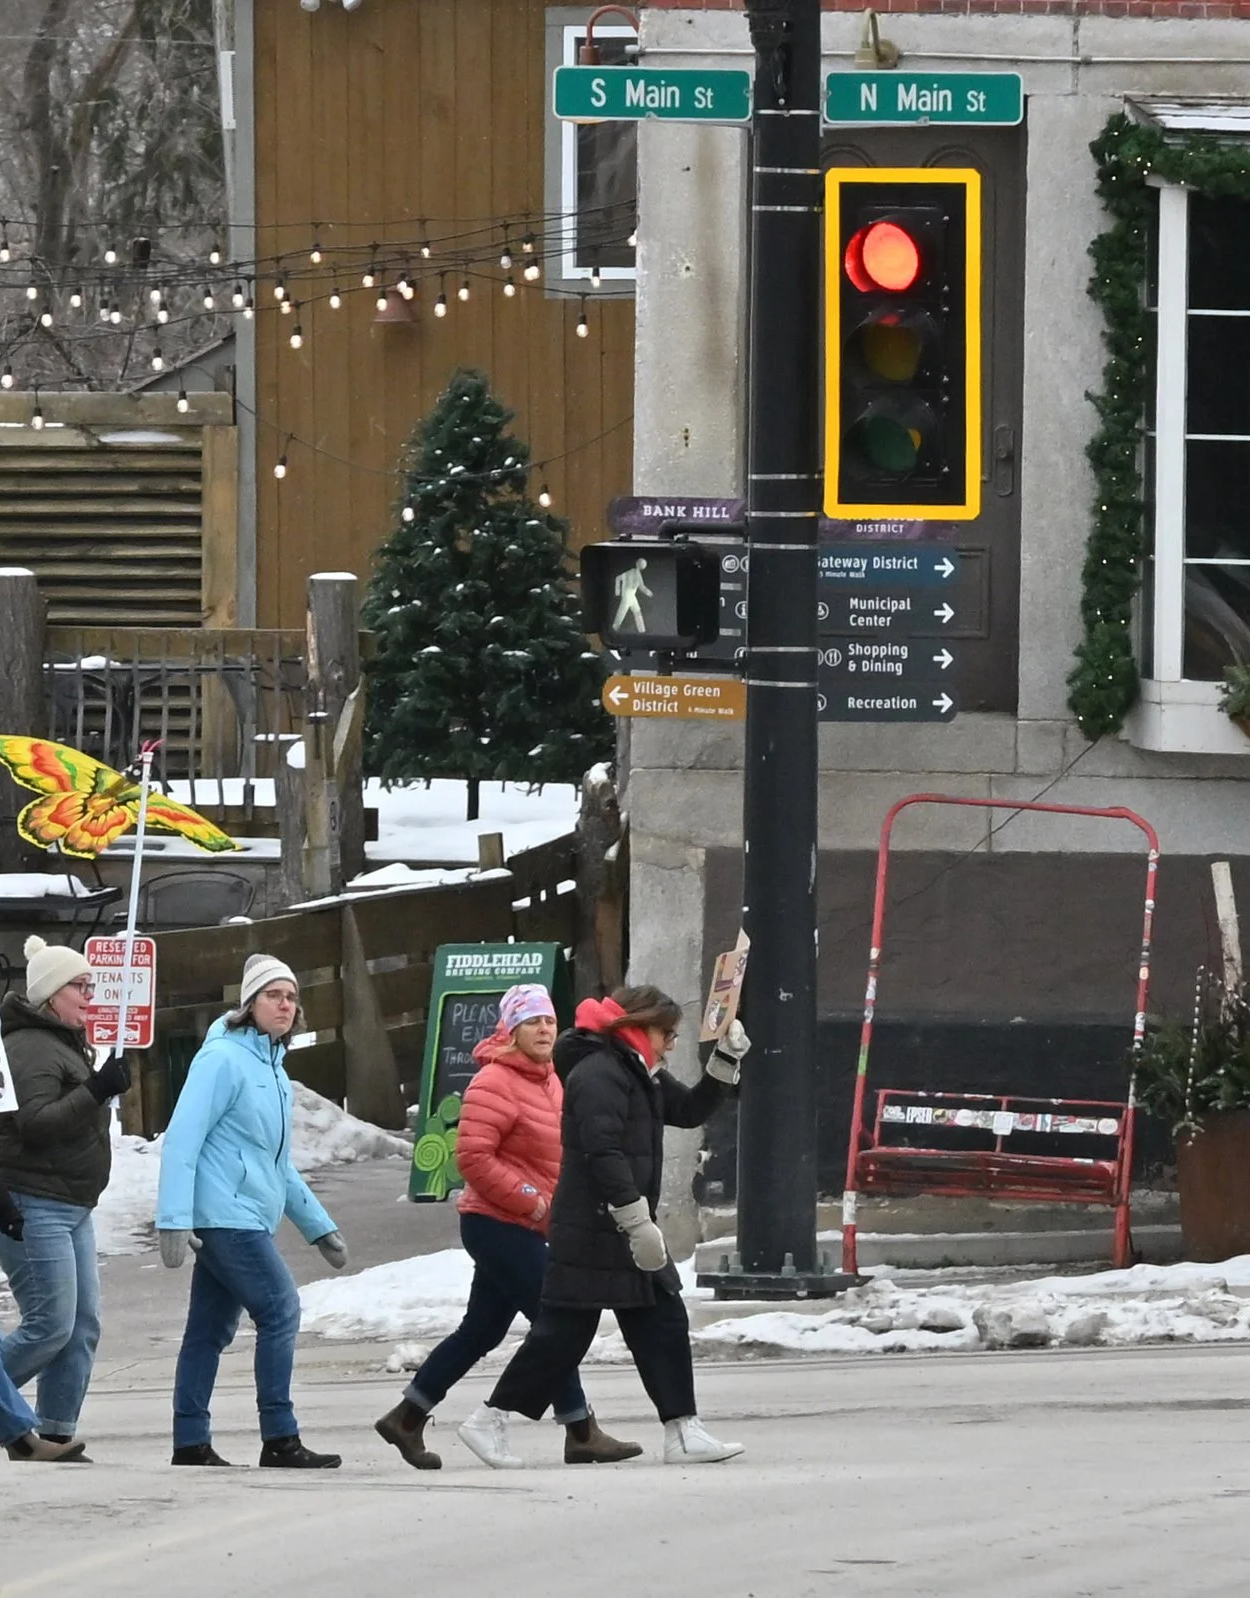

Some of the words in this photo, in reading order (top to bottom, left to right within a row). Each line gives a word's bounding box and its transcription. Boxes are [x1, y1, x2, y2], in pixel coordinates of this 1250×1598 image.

[591, 78, 607, 107] S
[625, 79, 680, 108] Main
[694, 87, 714, 109] St
[860, 83, 877, 111] N
[897, 83, 952, 112] Main
[966, 90, 986, 112] St
[642, 505, 687, 517] BANK
[692, 506, 730, 518] HILL
[856, 524, 904, 533] DISTRICT
[873, 556, 918, 570] District
[850, 597, 911, 613] Municipal
[850, 614, 892, 627] Center
[848, 643, 908, 659] Shopping
[848, 660, 857, 672] &
[862, 660, 903, 675] Dining
[633, 681, 678, 699] Village
[683, 684, 721, 697] Green
[632, 699, 679, 712] District
[848, 696, 917, 709] Recreation
[96, 941, 147, 953] RESERED
[90, 954, 125, 965] PARKIN
[132, 955, 151, 965] FOR
[446, 953, 543, 968] FIDDLEHEAD
[96, 972, 143, 984] TENATS
[445, 968, 491, 976] BREWING
[494, 967, 542, 975] COMPANY
[452, 1002, 497, 1026] PLEAS
